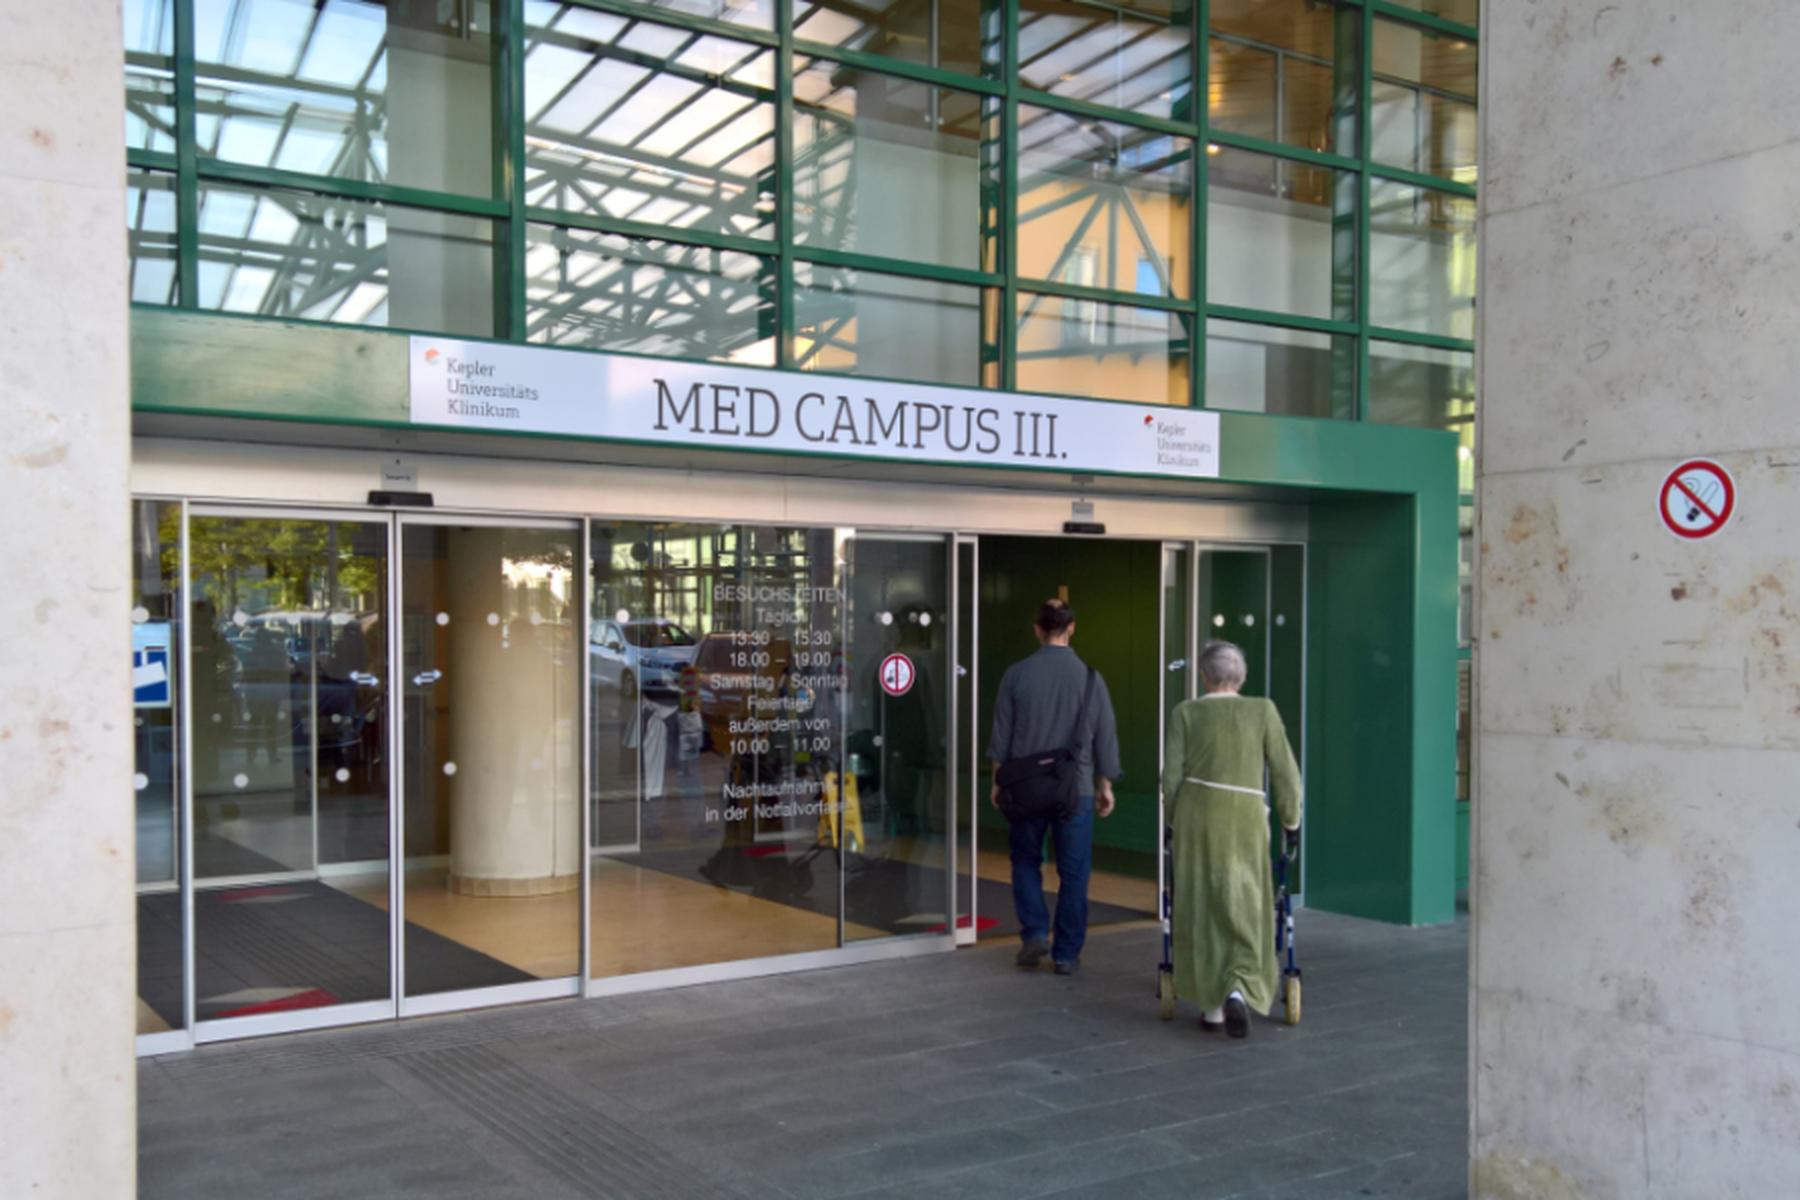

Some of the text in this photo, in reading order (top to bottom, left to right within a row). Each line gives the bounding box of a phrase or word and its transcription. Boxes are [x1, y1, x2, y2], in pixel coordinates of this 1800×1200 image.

[447, 358, 496, 379] Kepler
[447, 378, 539, 401] Universitäts
[447, 398, 520, 418] Klinikum
[652, 378, 1068, 460] MED CAMPUS III.
[714, 585, 846, 602] BESUCHSZEITEN
[794, 630, 832, 646] 15.30
[729, 651, 770, 667] 18.00
[794, 651, 832, 668] 19.00
[710, 674, 775, 690] Samstag
[791, 673, 848, 690] Sonntag
[729, 717, 831, 733] außerdem von
[729, 739, 770, 754] 10.00
[794, 737, 831, 751] 11.00
[705, 806, 719, 822] in
[723, 804, 749, 821] der
